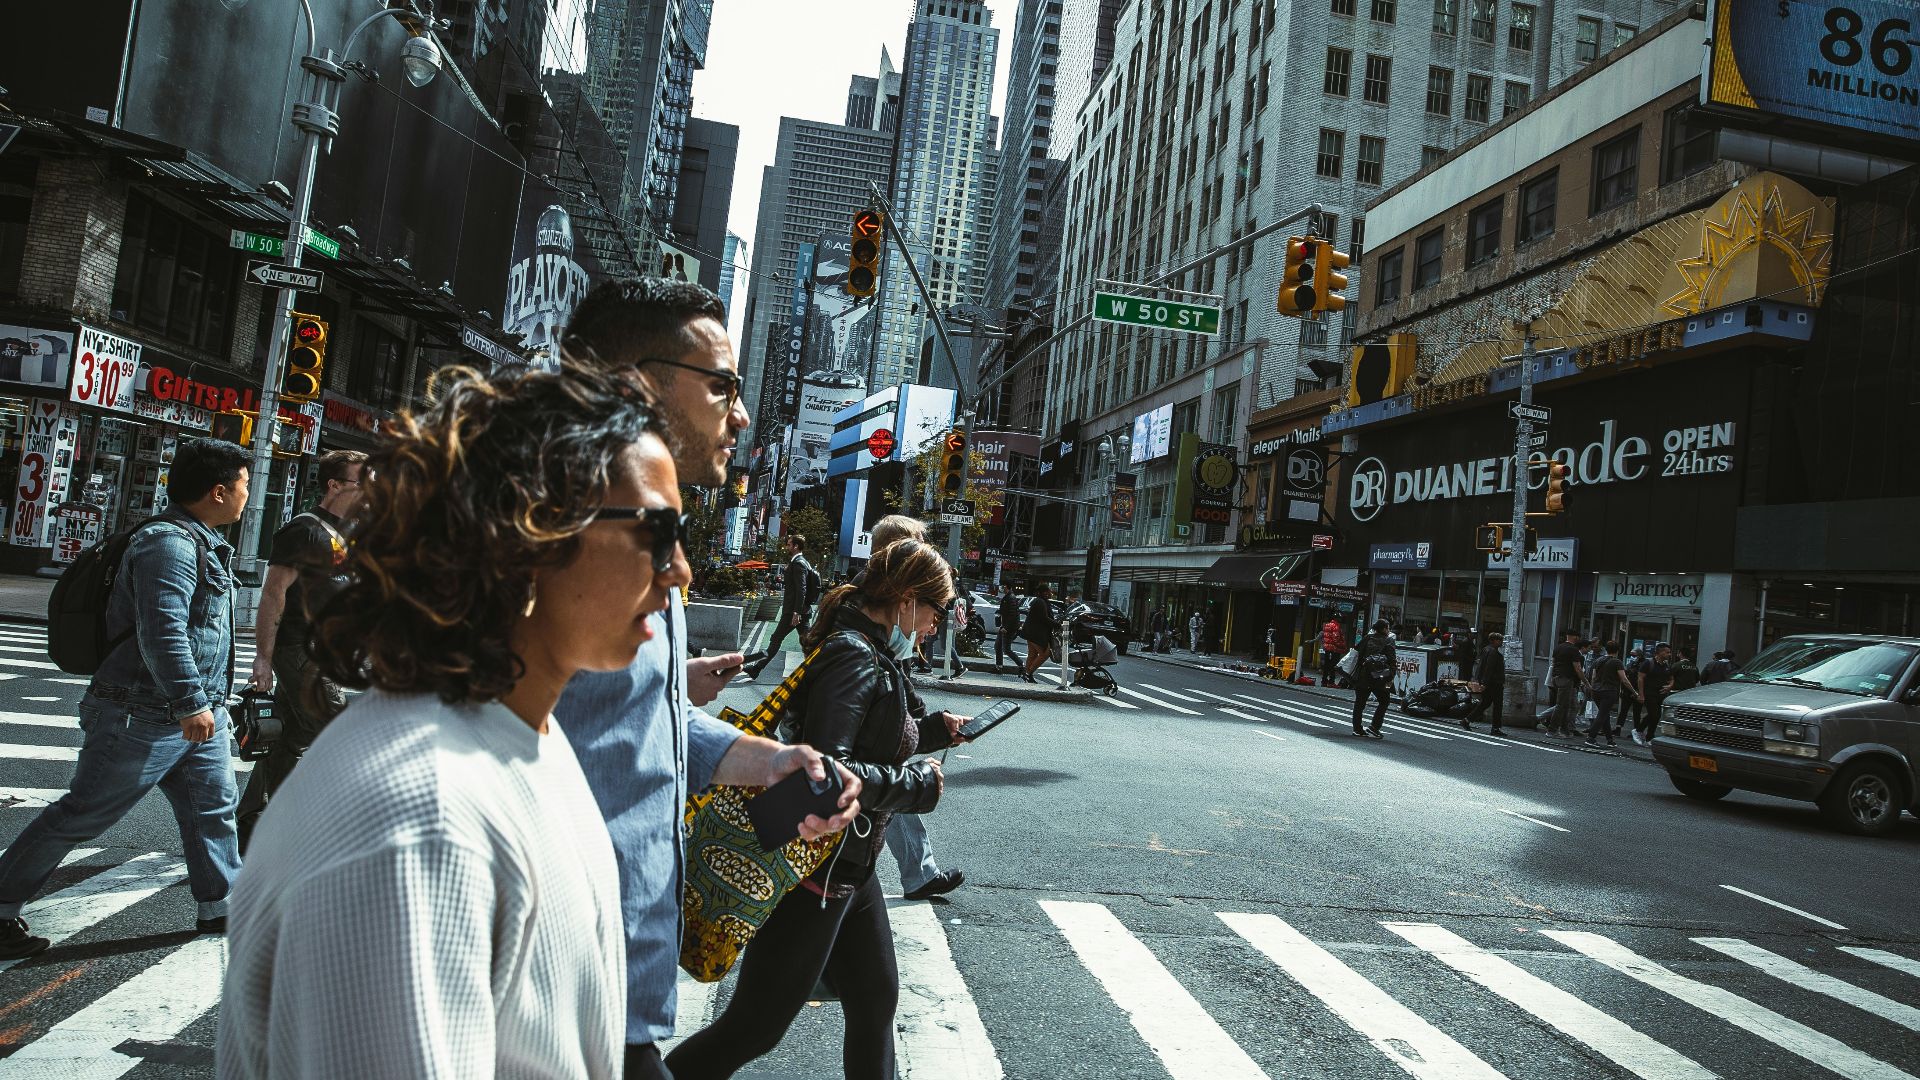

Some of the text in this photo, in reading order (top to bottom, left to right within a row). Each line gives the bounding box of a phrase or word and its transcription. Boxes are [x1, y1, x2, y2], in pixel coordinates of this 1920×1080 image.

[1820, 7, 1911, 76] 86
[1807, 68, 1919, 106] MILLION
[246, 235, 256, 249] W
[259, 238, 273, 252] 50
[309, 231, 338, 259] Broadway
[261, 269, 312, 285] ONE WAY
[1110, 300, 1204, 328] W 50 ST
[83, 329, 100, 350] NY
[465, 330, 505, 362] OUTFRONT
[1576, 321, 1684, 369] CENTER
[785, 326, 802, 405] SQUARE
[77, 352, 94, 400] 3
[98, 358, 120, 407] 10
[121, 361, 134, 377] 99
[221, 387, 238, 410] &
[30, 416, 56, 435] NY
[373, 418, 379, 434] &
[1517, 408, 1545, 418] ONE WAY
[976, 440, 1005, 454] hair
[1663, 421, 1736, 453] OPEN
[20, 453, 44, 501] 3
[1287, 456, 1323, 483] DR
[1661, 450, 1734, 477] 24hrs
[1350, 469, 1388, 509] DR
[15, 501, 35, 537] 30
[60, 508, 97, 521] SALE
[66, 519, 88, 530] NY
[943, 514, 972, 524] BIKE LANE
[1195, 508, 1229, 522] FOOD
[1176, 524, 1190, 536] TD
[1548, 545, 1569, 561] hrs
[1612, 576, 1703, 605] pharmacy
